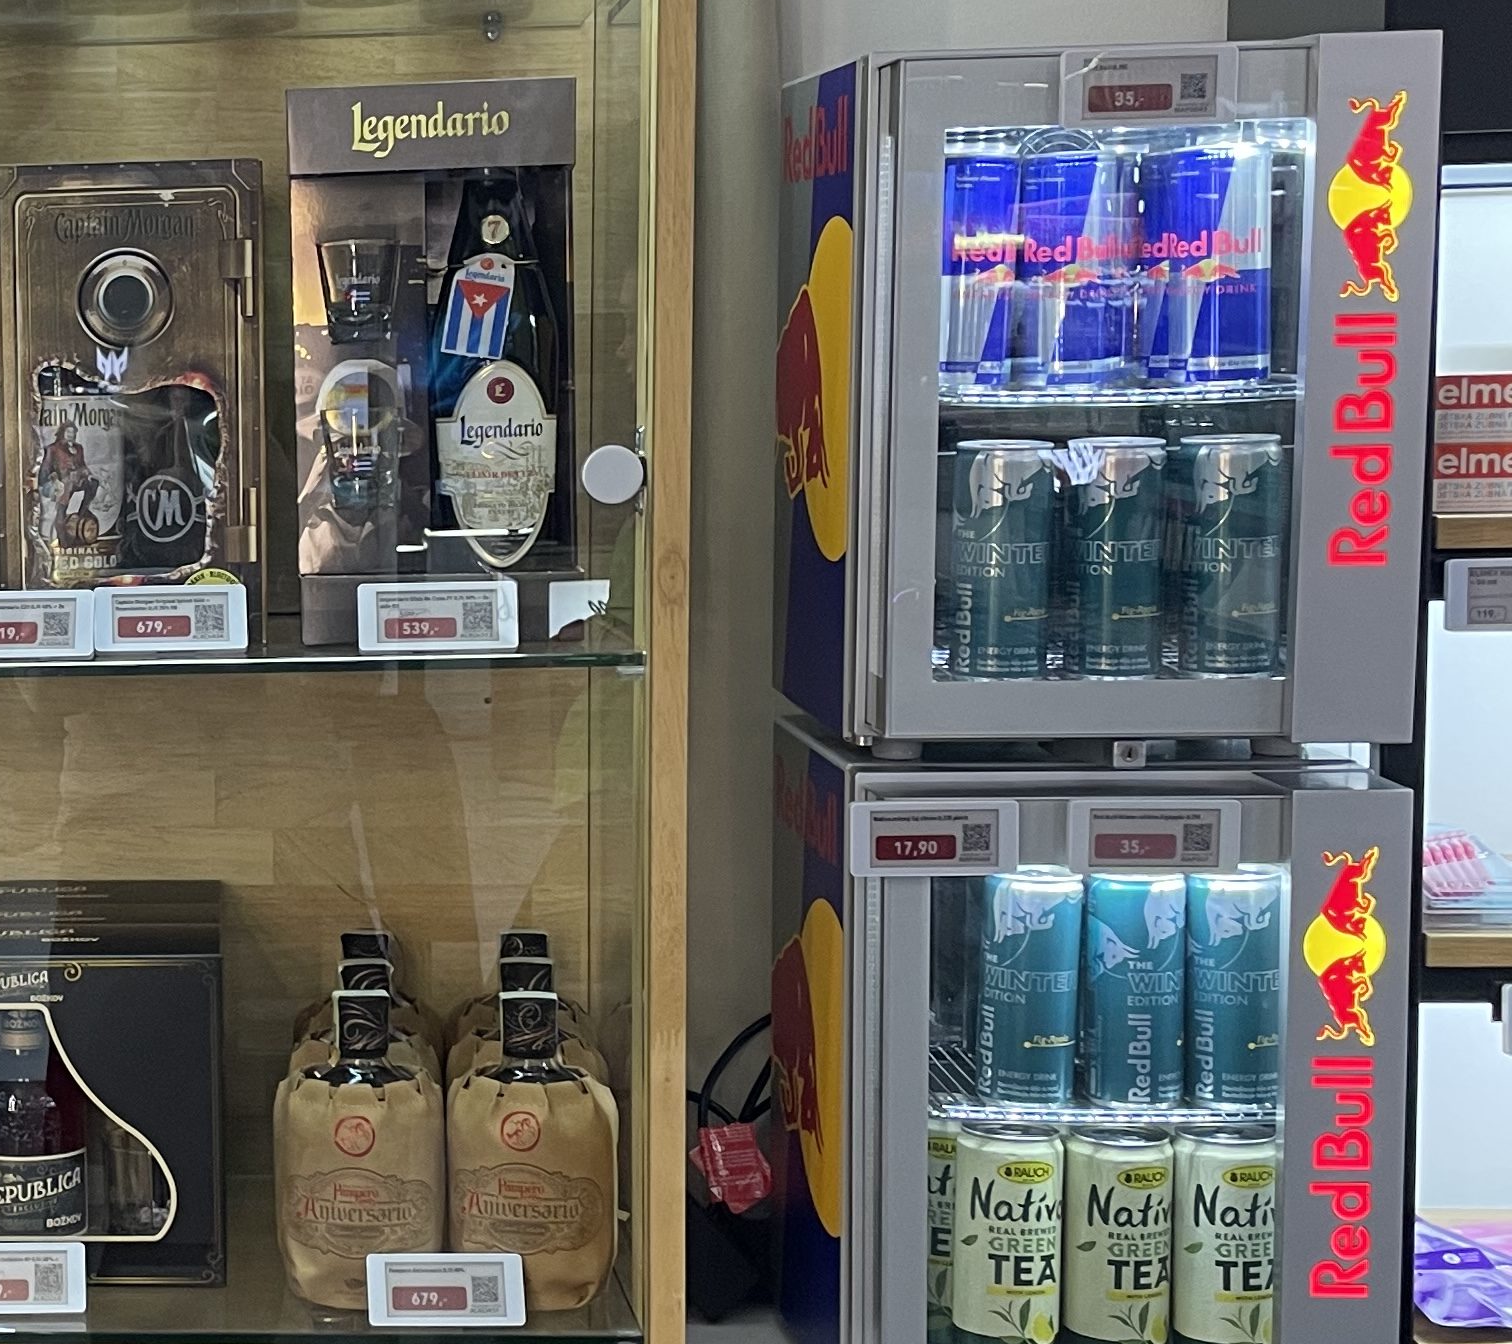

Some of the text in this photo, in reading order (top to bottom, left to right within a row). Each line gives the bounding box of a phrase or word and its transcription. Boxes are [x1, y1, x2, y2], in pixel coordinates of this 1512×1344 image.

[1114, 91, 1144, 107] 35,-
[351, 101, 510, 158] Legendario
[783, 95, 848, 183] Red Bull
[123, 210, 194, 238] Morgan
[1024, 235, 1072, 263] Red
[1161, 227, 1262, 259] Red Bull
[1438, 377, 1512, 405] elme
[460, 415, 543, 448] Legendario
[1327, 311, 1399, 567] Red Bull
[1437, 447, 1512, 475] elme
[957, 529, 976, 539] THE
[136, 621, 172, 634] 679,-
[403, 622, 439, 635] 539,-
[954, 582, 973, 673] Red Bull
[894, 841, 937, 855] 17,90
[1120, 840, 1151, 854] 35,-
[1127, 960, 1153, 970] THE
[978, 1005, 994, 1093] Red Bull
[1127, 1013, 1152, 1102] Red Bull
[1195, 1009, 1214, 1098] Red Bull
[1014, 1167, 1050, 1178] RAUCH
[1133, 1172, 1166, 1183] RAUCH
[1309, 1056, 1376, 1299] Red Bull
[296, 1192, 413, 1223] Aniversario
[462, 1190, 580, 1220] Aniversario
[46, 1212, 82, 1228] BOŽKOV
[989, 1226, 1016, 1235] REAL
[988, 1237, 1056, 1253] GREEN
[1108, 1232, 1136, 1241] REAL
[1215, 1232, 1242, 1241] REAL
[988, 1255, 1057, 1285] TEA
[1107, 1259, 1169, 1290] TEA
[411, 1292, 448, 1306] 679,-
